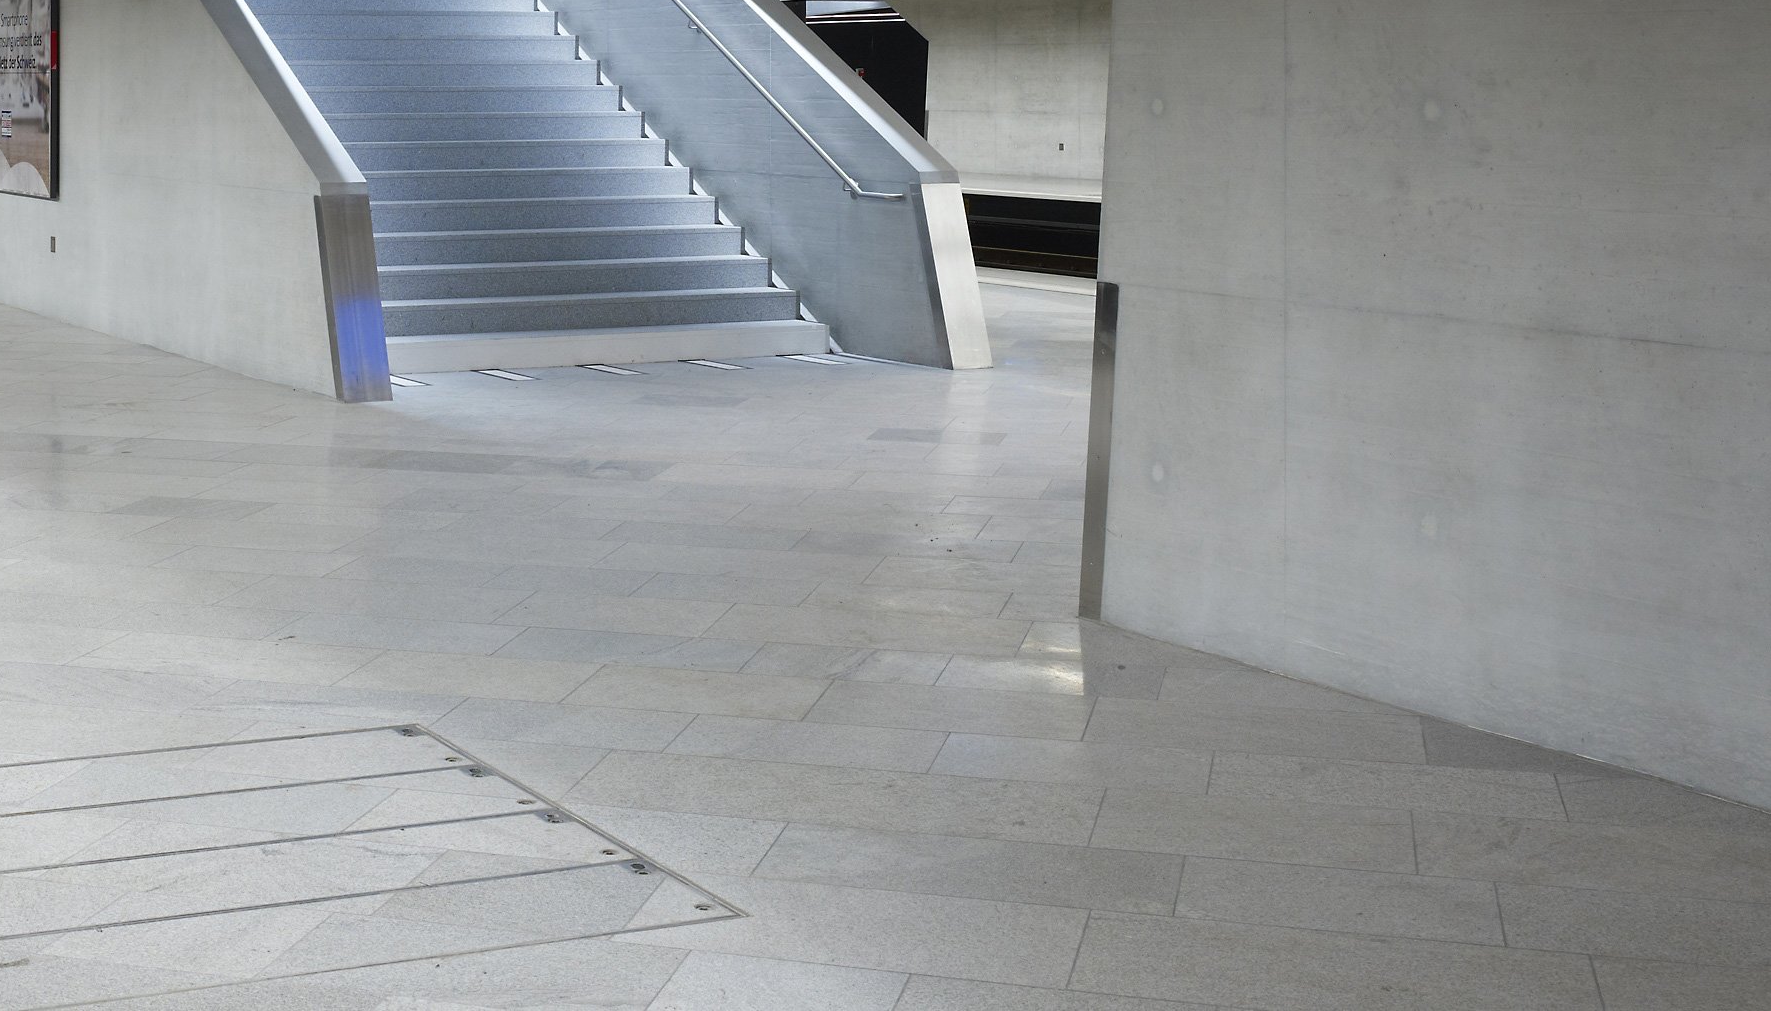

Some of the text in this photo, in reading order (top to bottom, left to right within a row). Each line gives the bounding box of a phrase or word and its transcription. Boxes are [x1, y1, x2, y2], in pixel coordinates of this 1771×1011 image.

[1, 13, 28, 30] Smartphone
[14, 32, 33, 47] verdient
[33, 32, 42, 46] das
